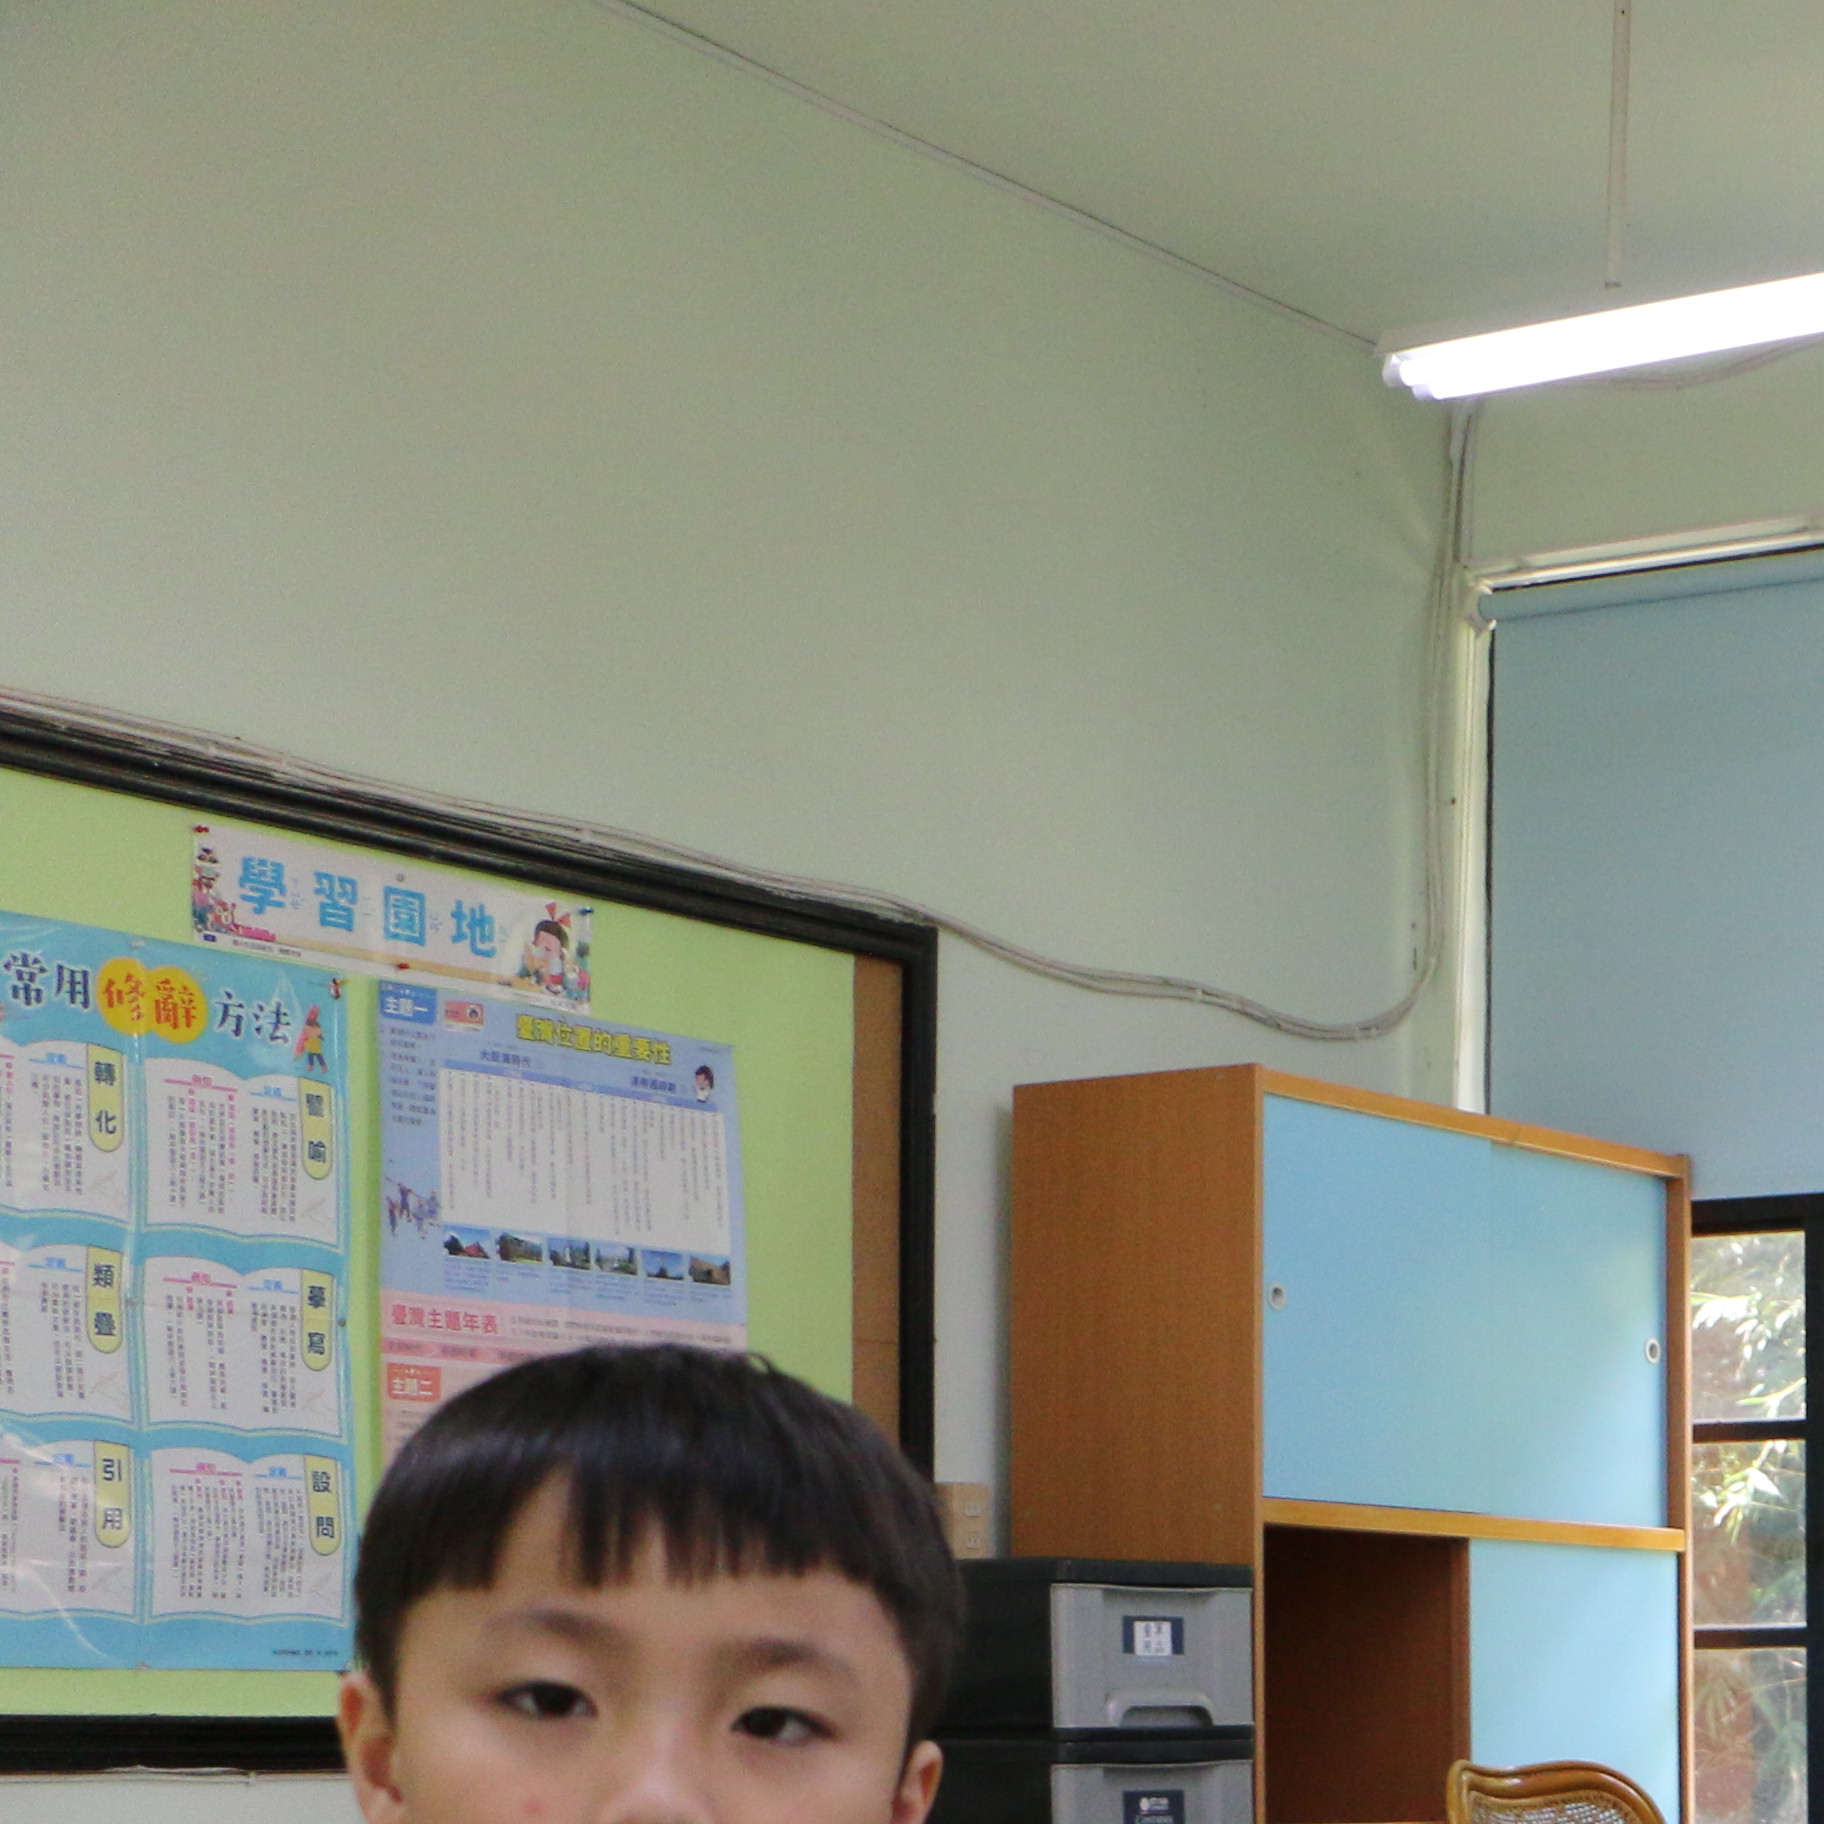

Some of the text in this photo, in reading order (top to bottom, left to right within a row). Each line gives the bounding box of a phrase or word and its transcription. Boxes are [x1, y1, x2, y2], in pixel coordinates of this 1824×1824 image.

[239, 856, 497, 958] 學習園地
[3, 951, 291, 1044] 常用修辭方法
[94, 1061, 116, 1135] 轉化
[93, 1263, 116, 1336] 類疊
[101, 1457, 123, 1531] 引用
[312, 1470, 335, 1540] 設問
